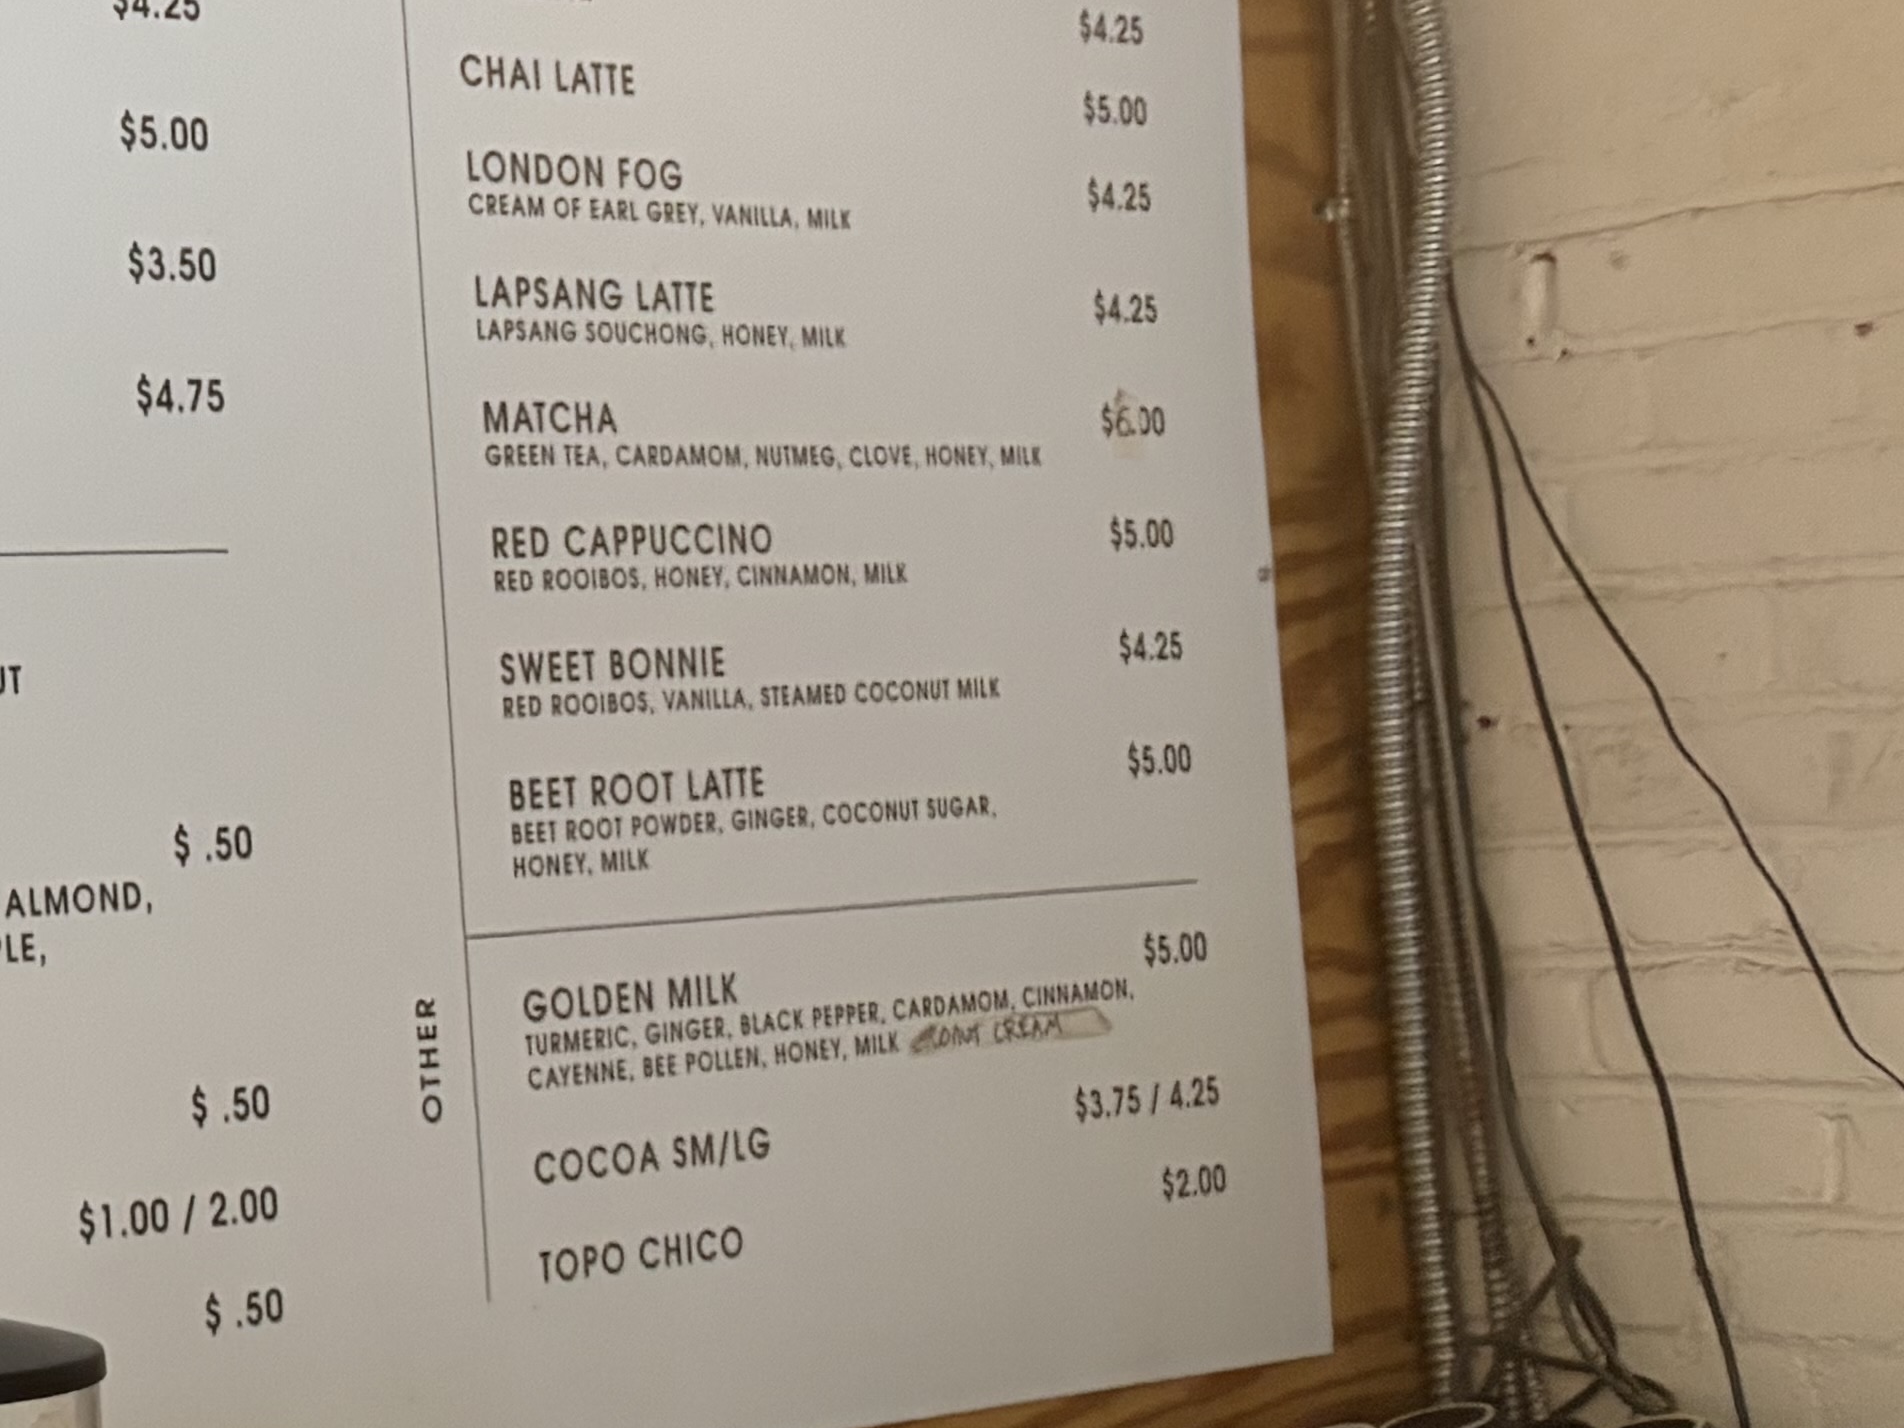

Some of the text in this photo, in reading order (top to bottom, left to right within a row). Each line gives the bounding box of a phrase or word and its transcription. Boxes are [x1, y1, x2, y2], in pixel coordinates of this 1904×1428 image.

[458, 52, 636, 97] CHAI LATTE
[1082, 89, 1148, 128] $5.00
[465, 148, 684, 193] LONDON FOG
[466, 190, 853, 234] CREAM OF EARL GREY, VANILLA, MILK
[1087, 176, 1153, 214] $4.25
[127, 239, 218, 286] $3.50
[135, 371, 226, 418] $4.75
[481, 399, 619, 435] MATCHA
[490, 521, 774, 560] RED CAPPUCCINO
[1109, 514, 1175, 553] $5.00
[498, 644, 727, 687] SWEET BONNIE
[1118, 627, 1184, 667] $4.25
[1142, 930, 1209, 970] $5.00
[521, 970, 739, 1025] GOLDEN MILK
[414, 997, 444, 1125] OTHER
[533, 1125, 772, 1187] COCOA SM/LG
[1161, 1162, 1228, 1204] $2.00
[537, 1224, 745, 1285] TOPO CHICO
